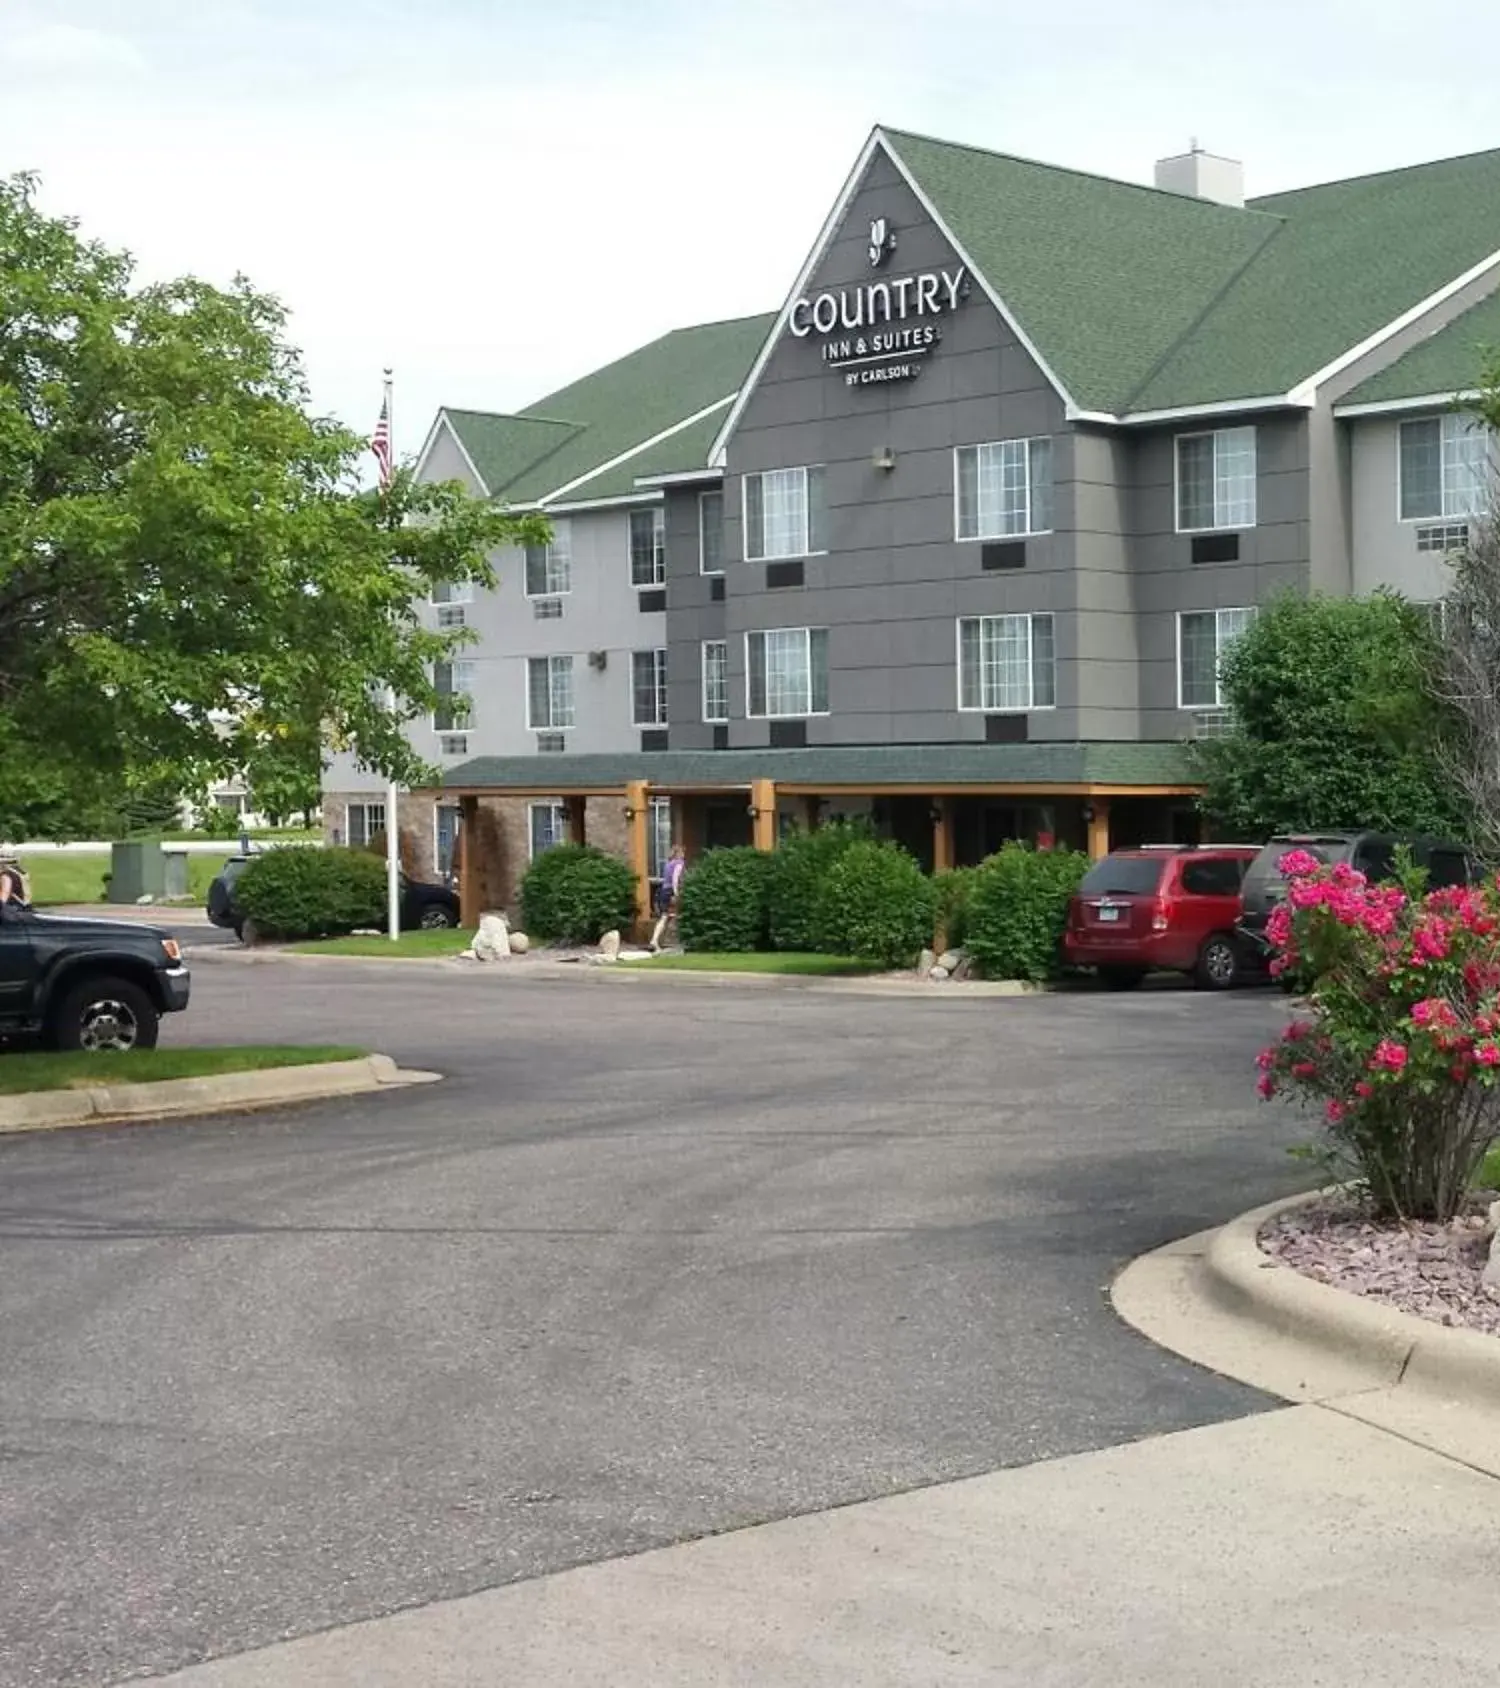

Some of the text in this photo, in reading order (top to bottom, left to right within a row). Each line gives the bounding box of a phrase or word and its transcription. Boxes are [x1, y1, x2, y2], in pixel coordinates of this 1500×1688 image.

[789, 266, 966, 337] COUNTRY
[821, 326, 934, 360] INN & SUITES
[845, 364, 909, 385] BY CARLSON
